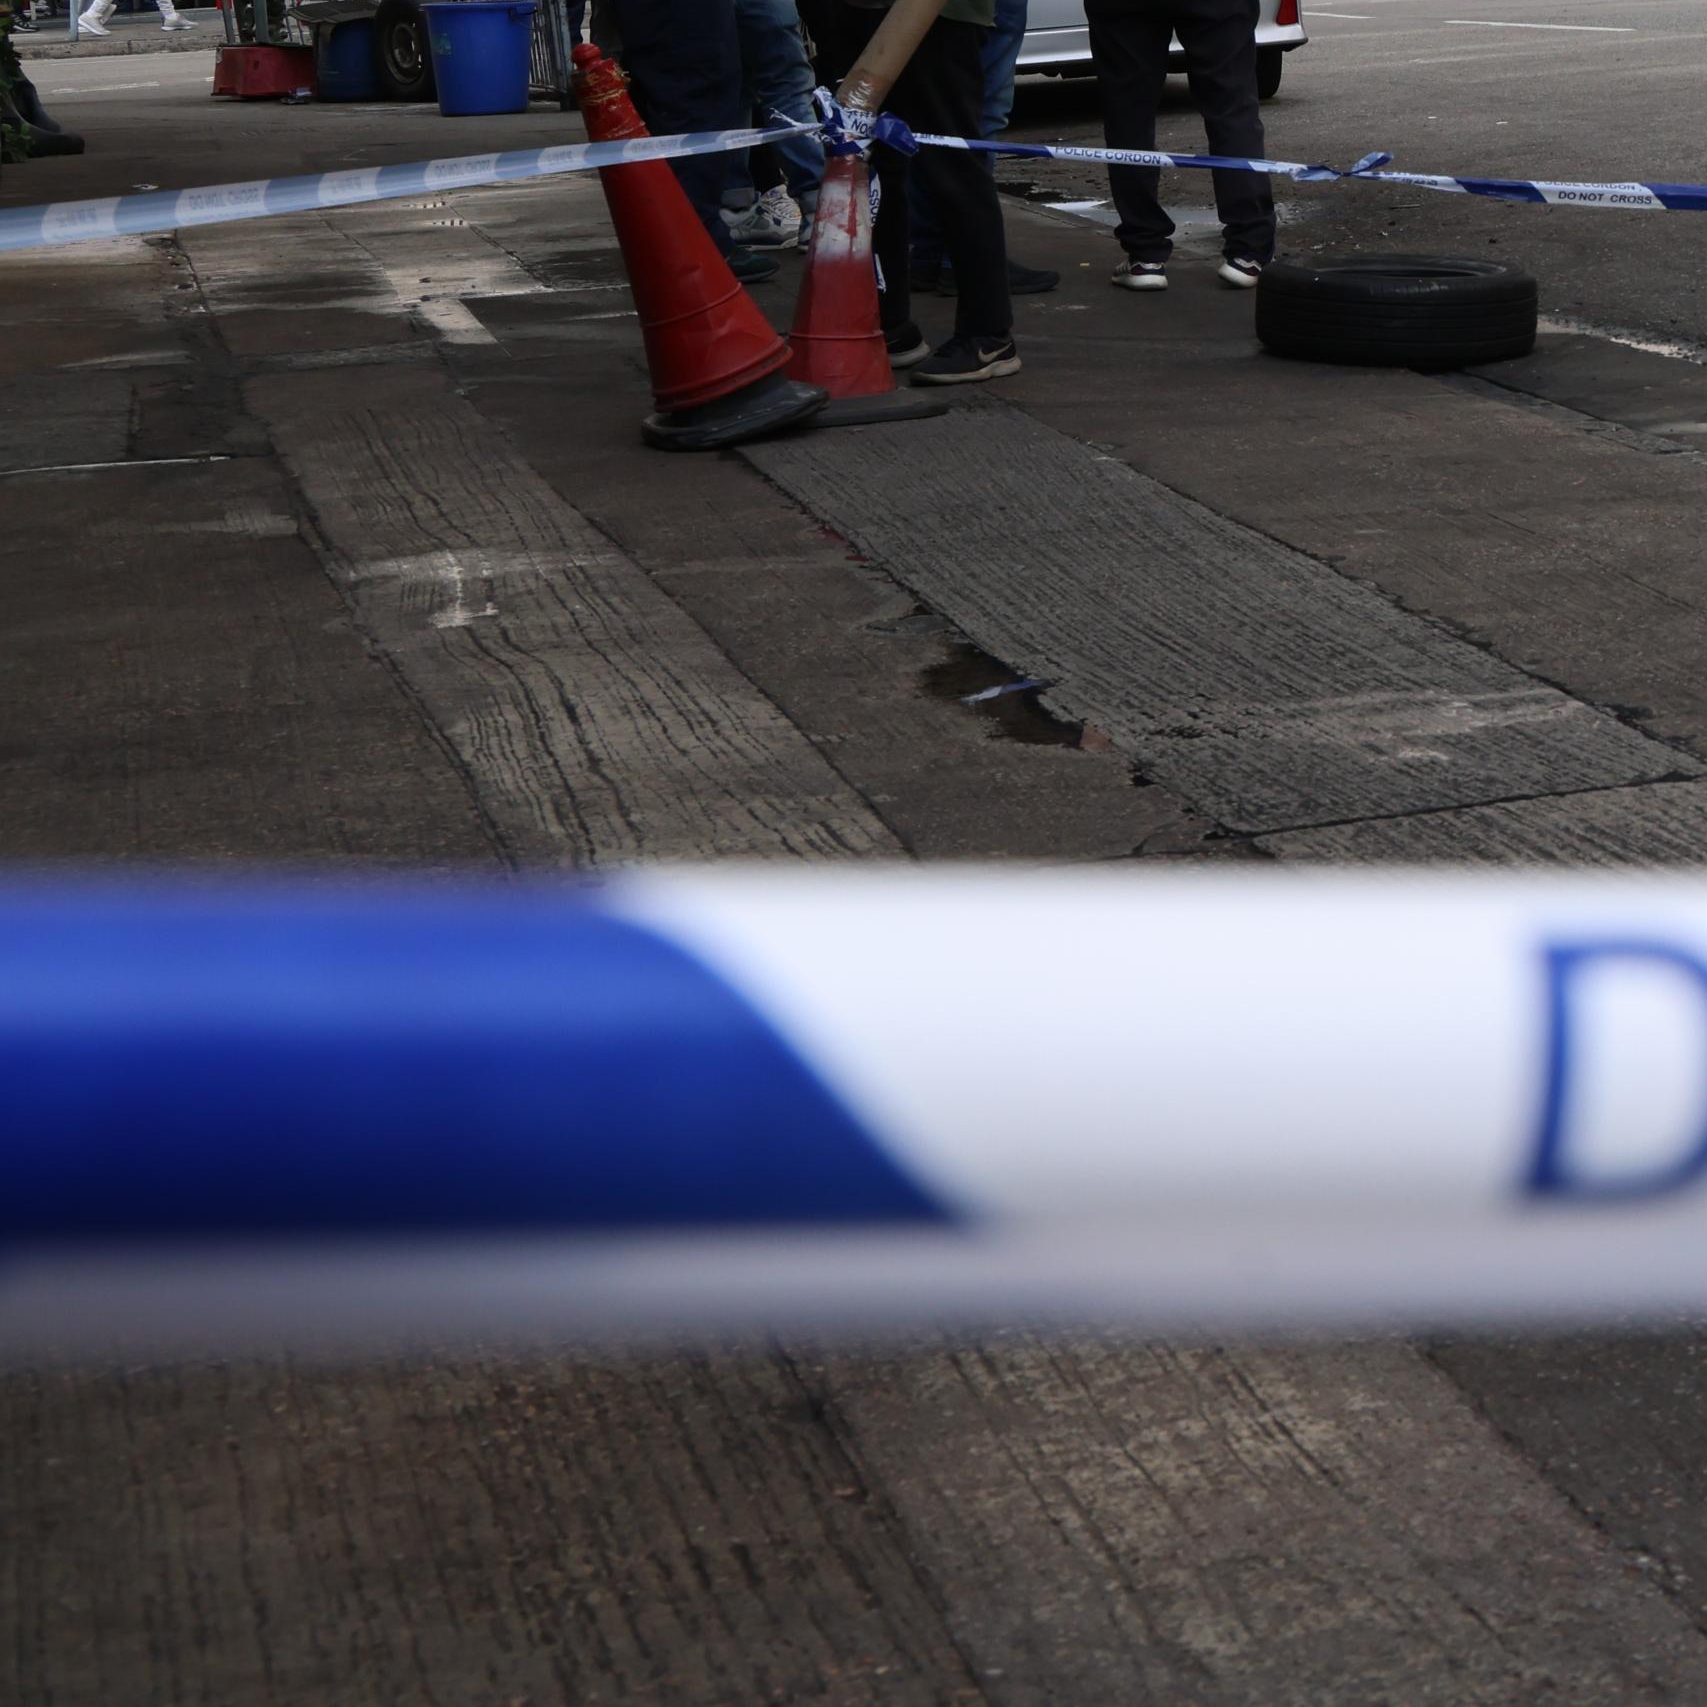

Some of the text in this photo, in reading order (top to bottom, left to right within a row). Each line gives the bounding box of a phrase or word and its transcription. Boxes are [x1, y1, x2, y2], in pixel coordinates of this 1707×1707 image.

[1055, 146, 1162, 165] POLICE CORDON
[1558, 191, 1653, 205] DO NOT CROSS
